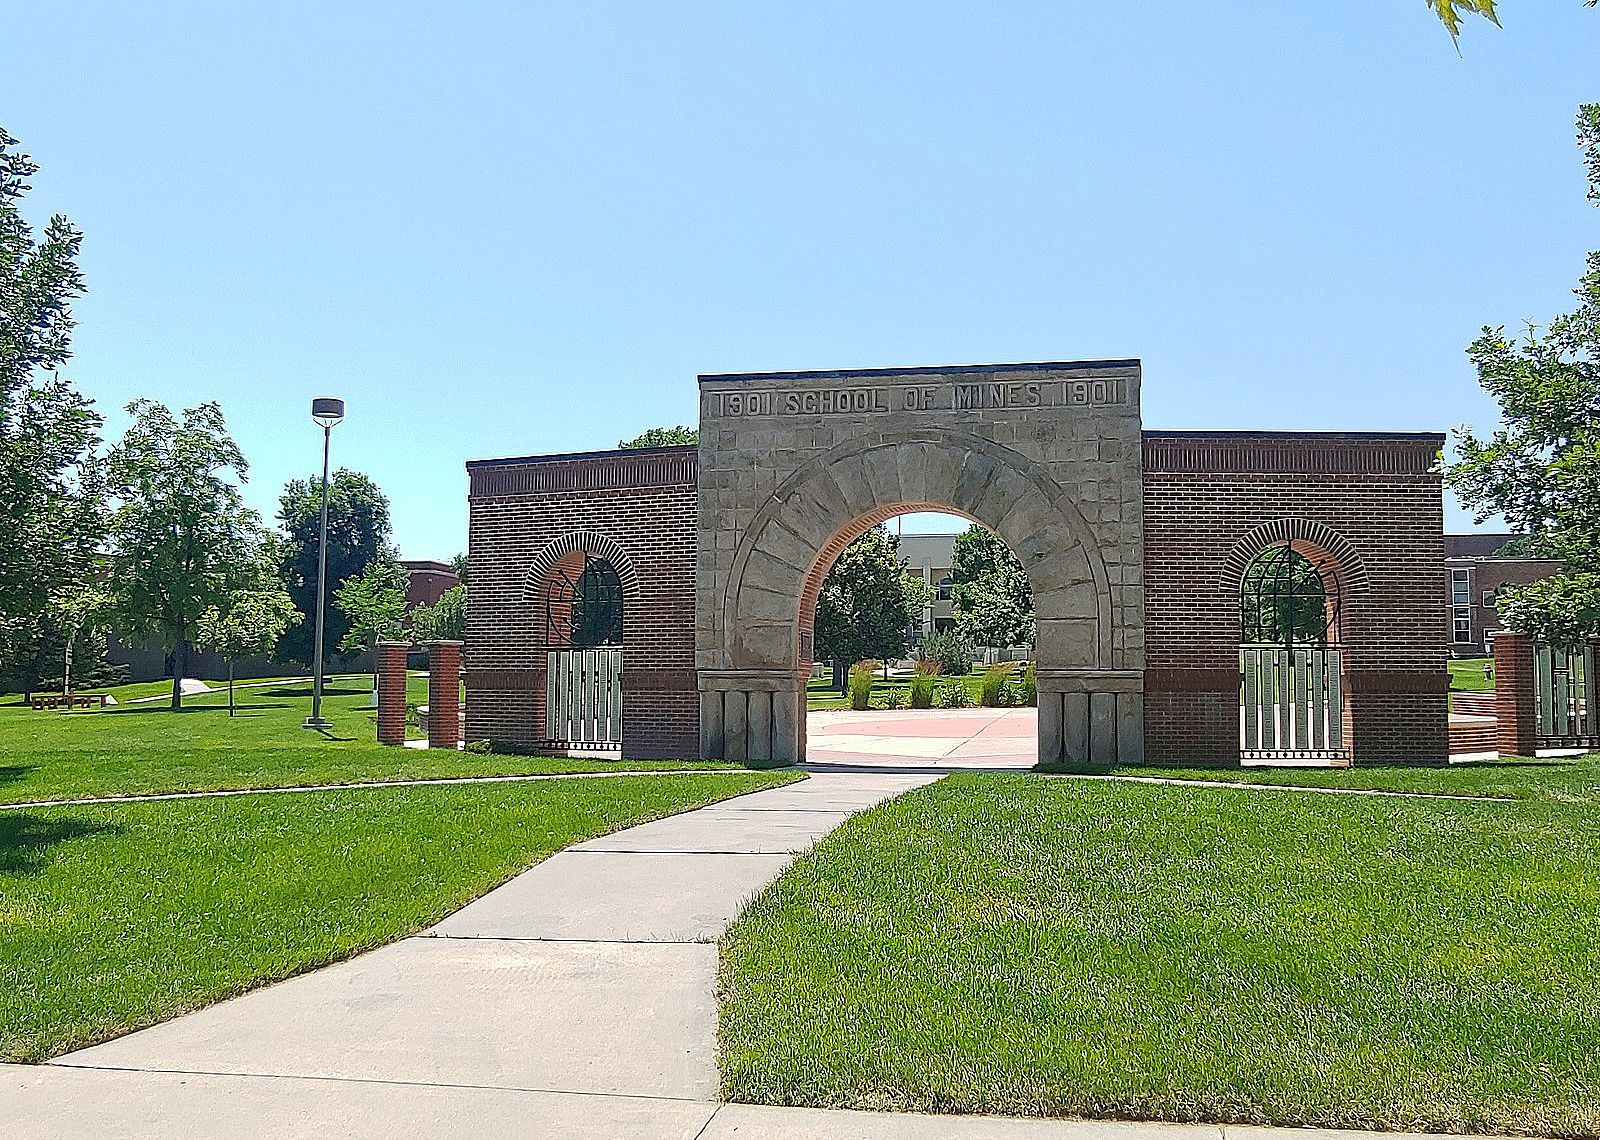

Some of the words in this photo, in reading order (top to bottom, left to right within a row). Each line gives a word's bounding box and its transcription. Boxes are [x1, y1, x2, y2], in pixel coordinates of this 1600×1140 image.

[718, 392, 771, 417] 1901
[785, 388, 886, 415] SCHOOL
[904, 386, 936, 411] OF
[956, 382, 1042, 410] MINES
[1062, 379, 1119, 406] 1901
